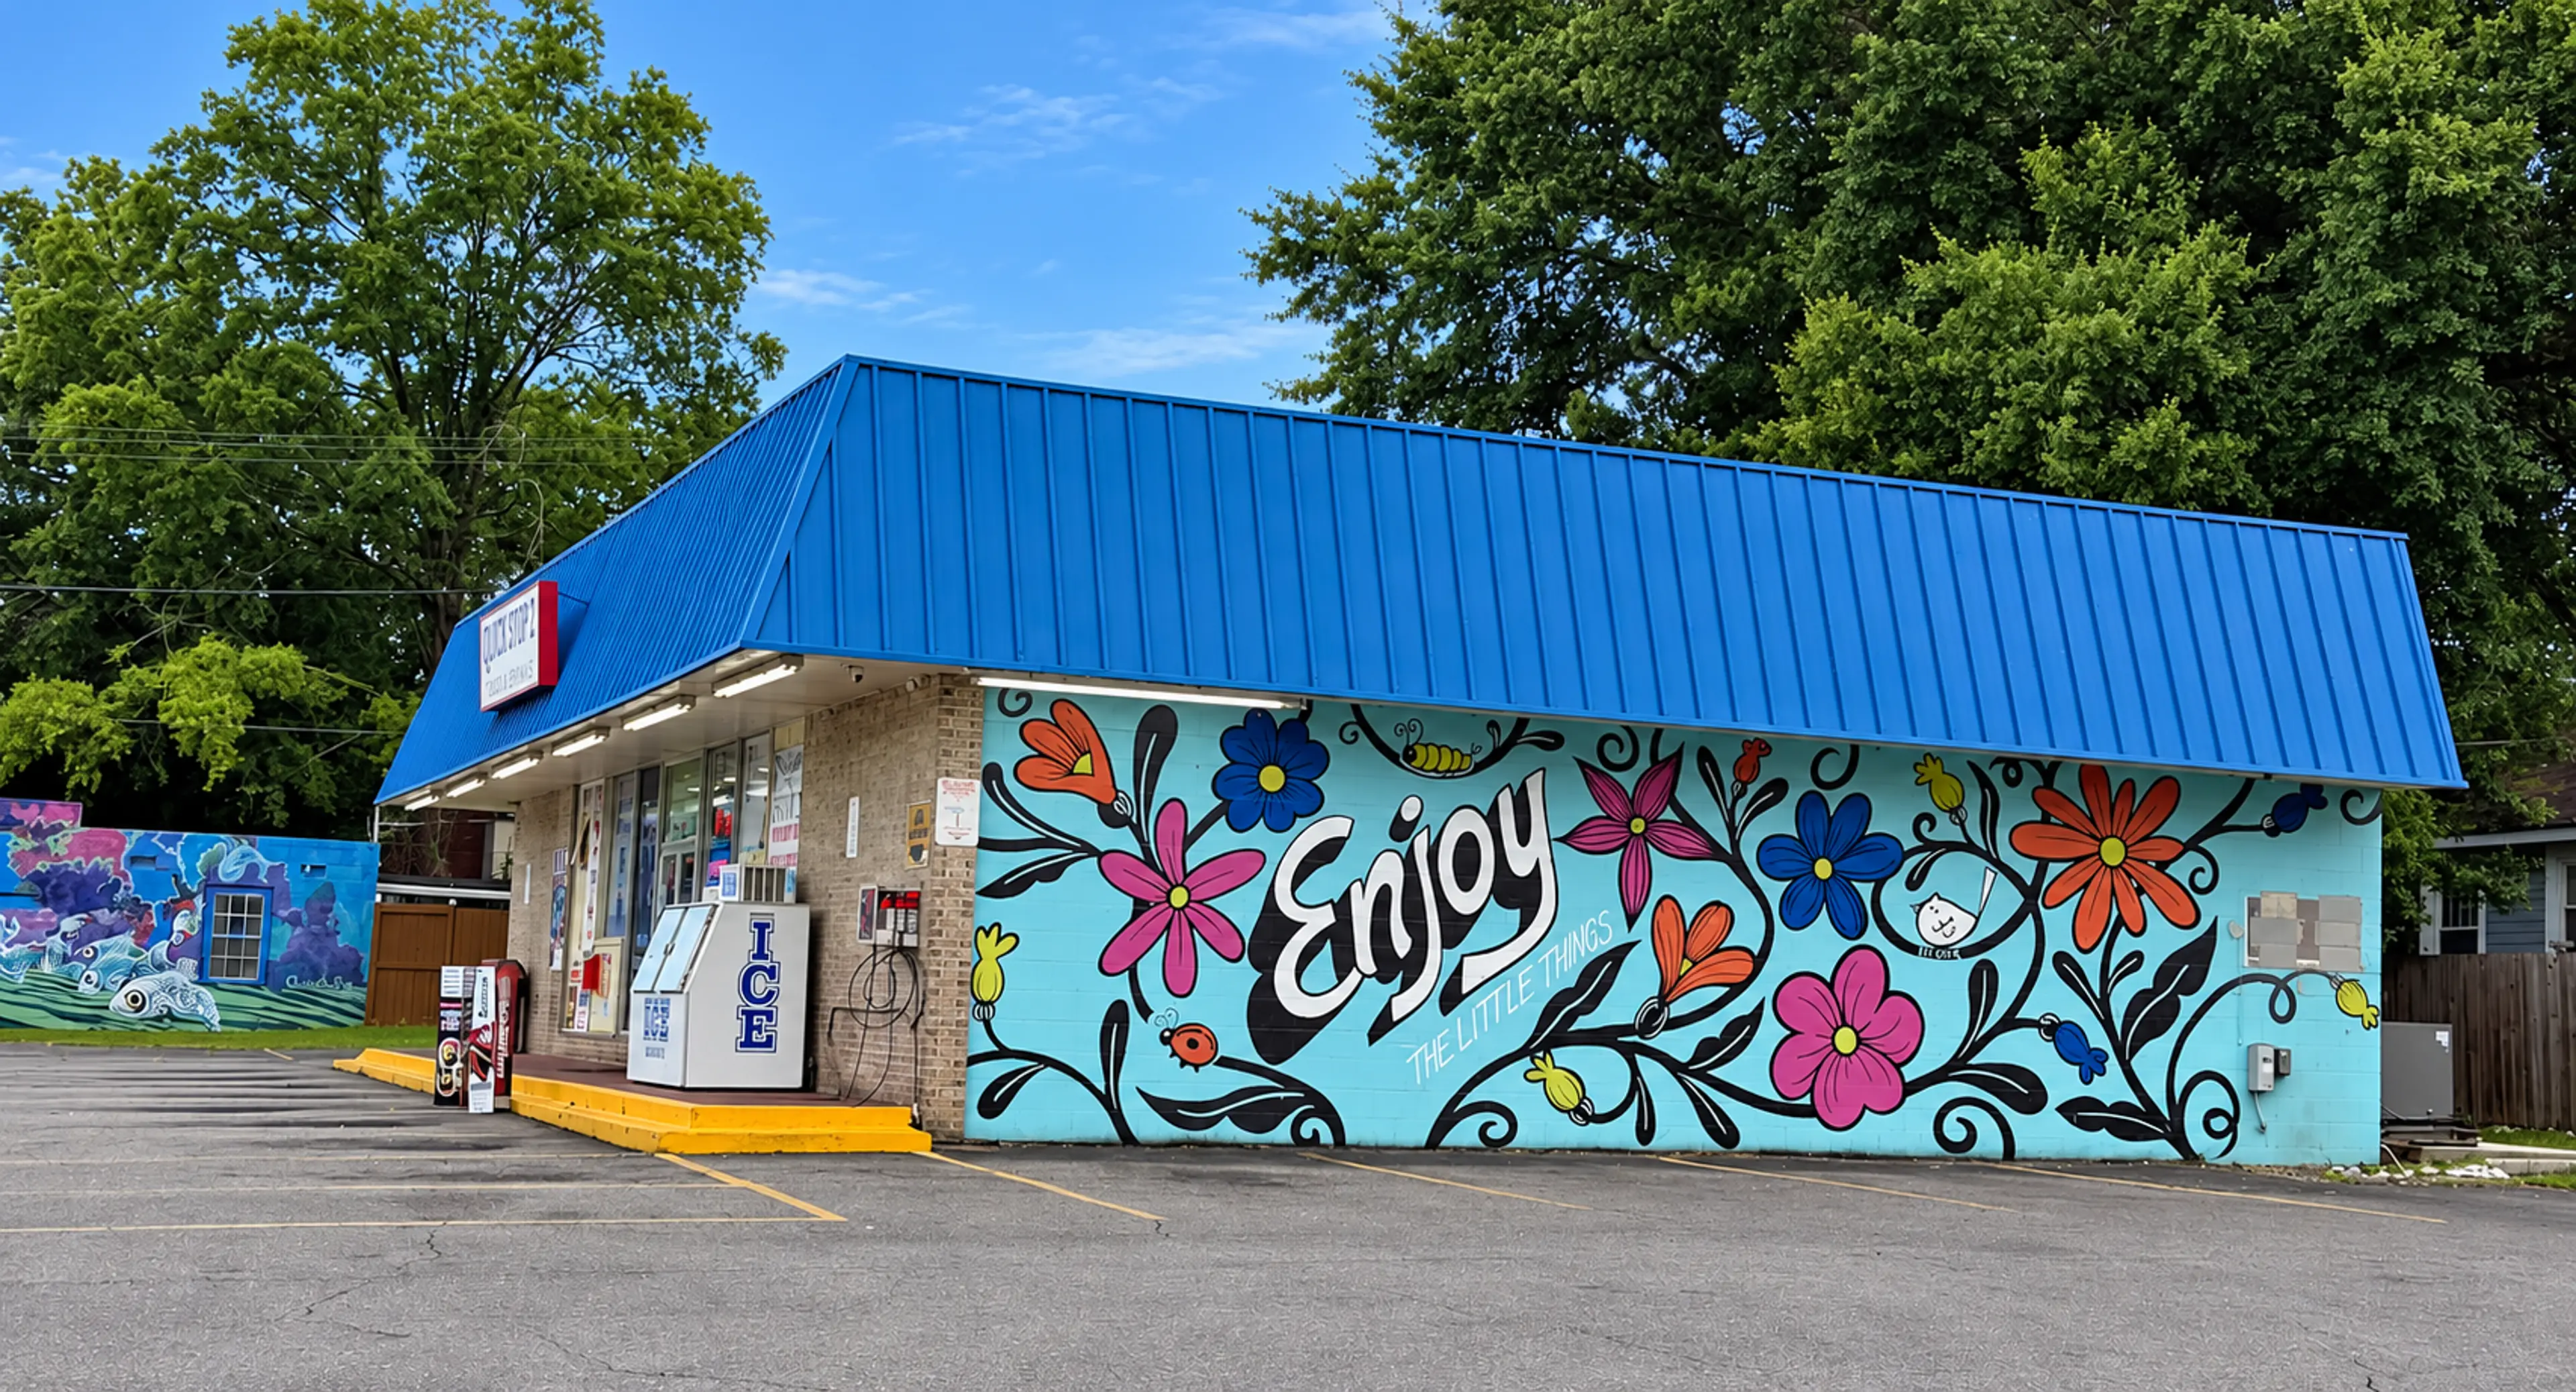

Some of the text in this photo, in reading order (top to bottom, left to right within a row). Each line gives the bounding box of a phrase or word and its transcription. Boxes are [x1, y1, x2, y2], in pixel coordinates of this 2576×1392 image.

[1269, 767, 1559, 1022] Enjoy
[735, 918, 780, 1053] ICE
[1406, 910, 1613, 1085] THE LITTLE THINGS
